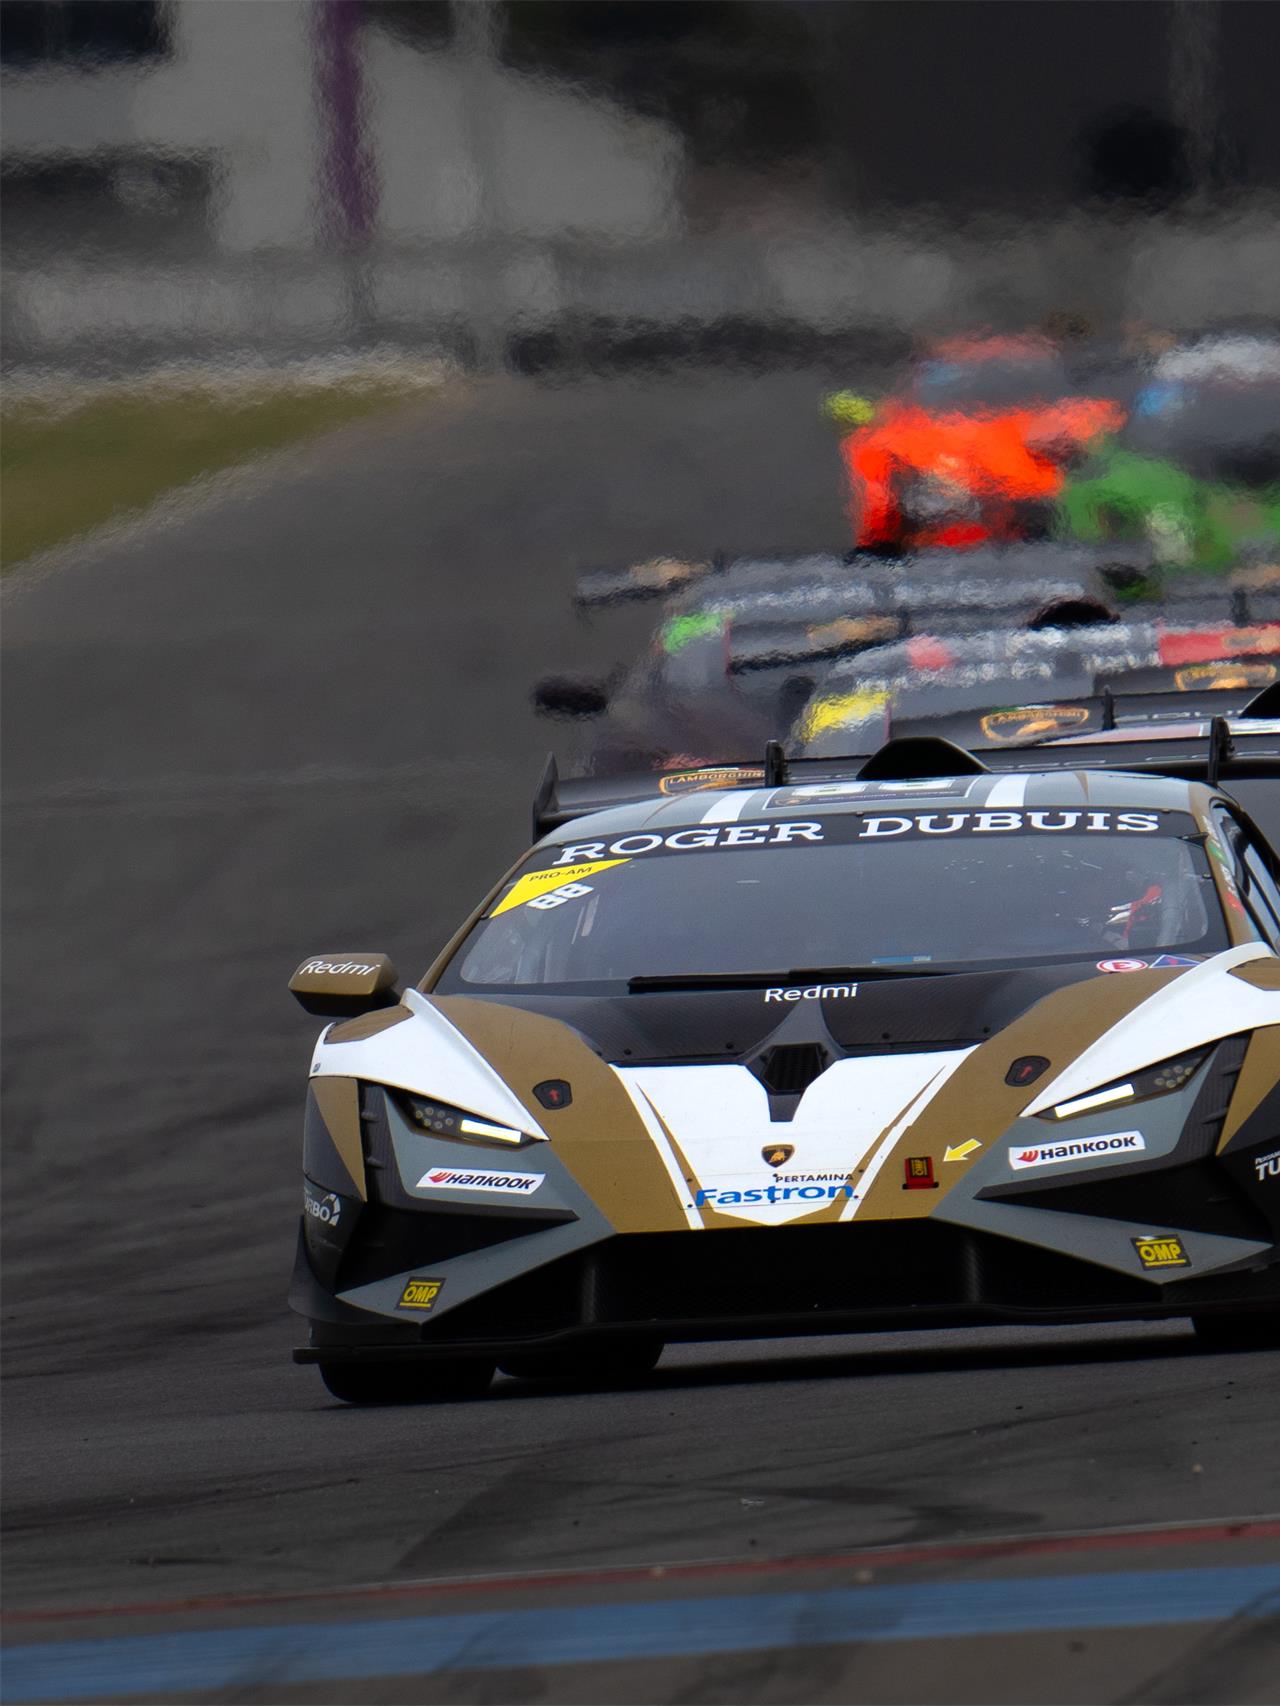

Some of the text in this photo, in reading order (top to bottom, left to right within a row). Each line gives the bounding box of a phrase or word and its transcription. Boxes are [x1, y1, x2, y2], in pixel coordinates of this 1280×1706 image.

[552, 811, 1160, 865] ROGER DUBUIS
[529, 866, 592, 882] PRO-AM
[526, 882, 594, 910] 88
[299, 960, 382, 976] Redmi
[764, 983, 859, 1003] Redmi
[775, 1173, 854, 1183] PERTAMINA
[696, 1185, 854, 1207] Fastron
[1140, 1243, 1181, 1262] OMP
[403, 1286, 438, 1302] OMP
